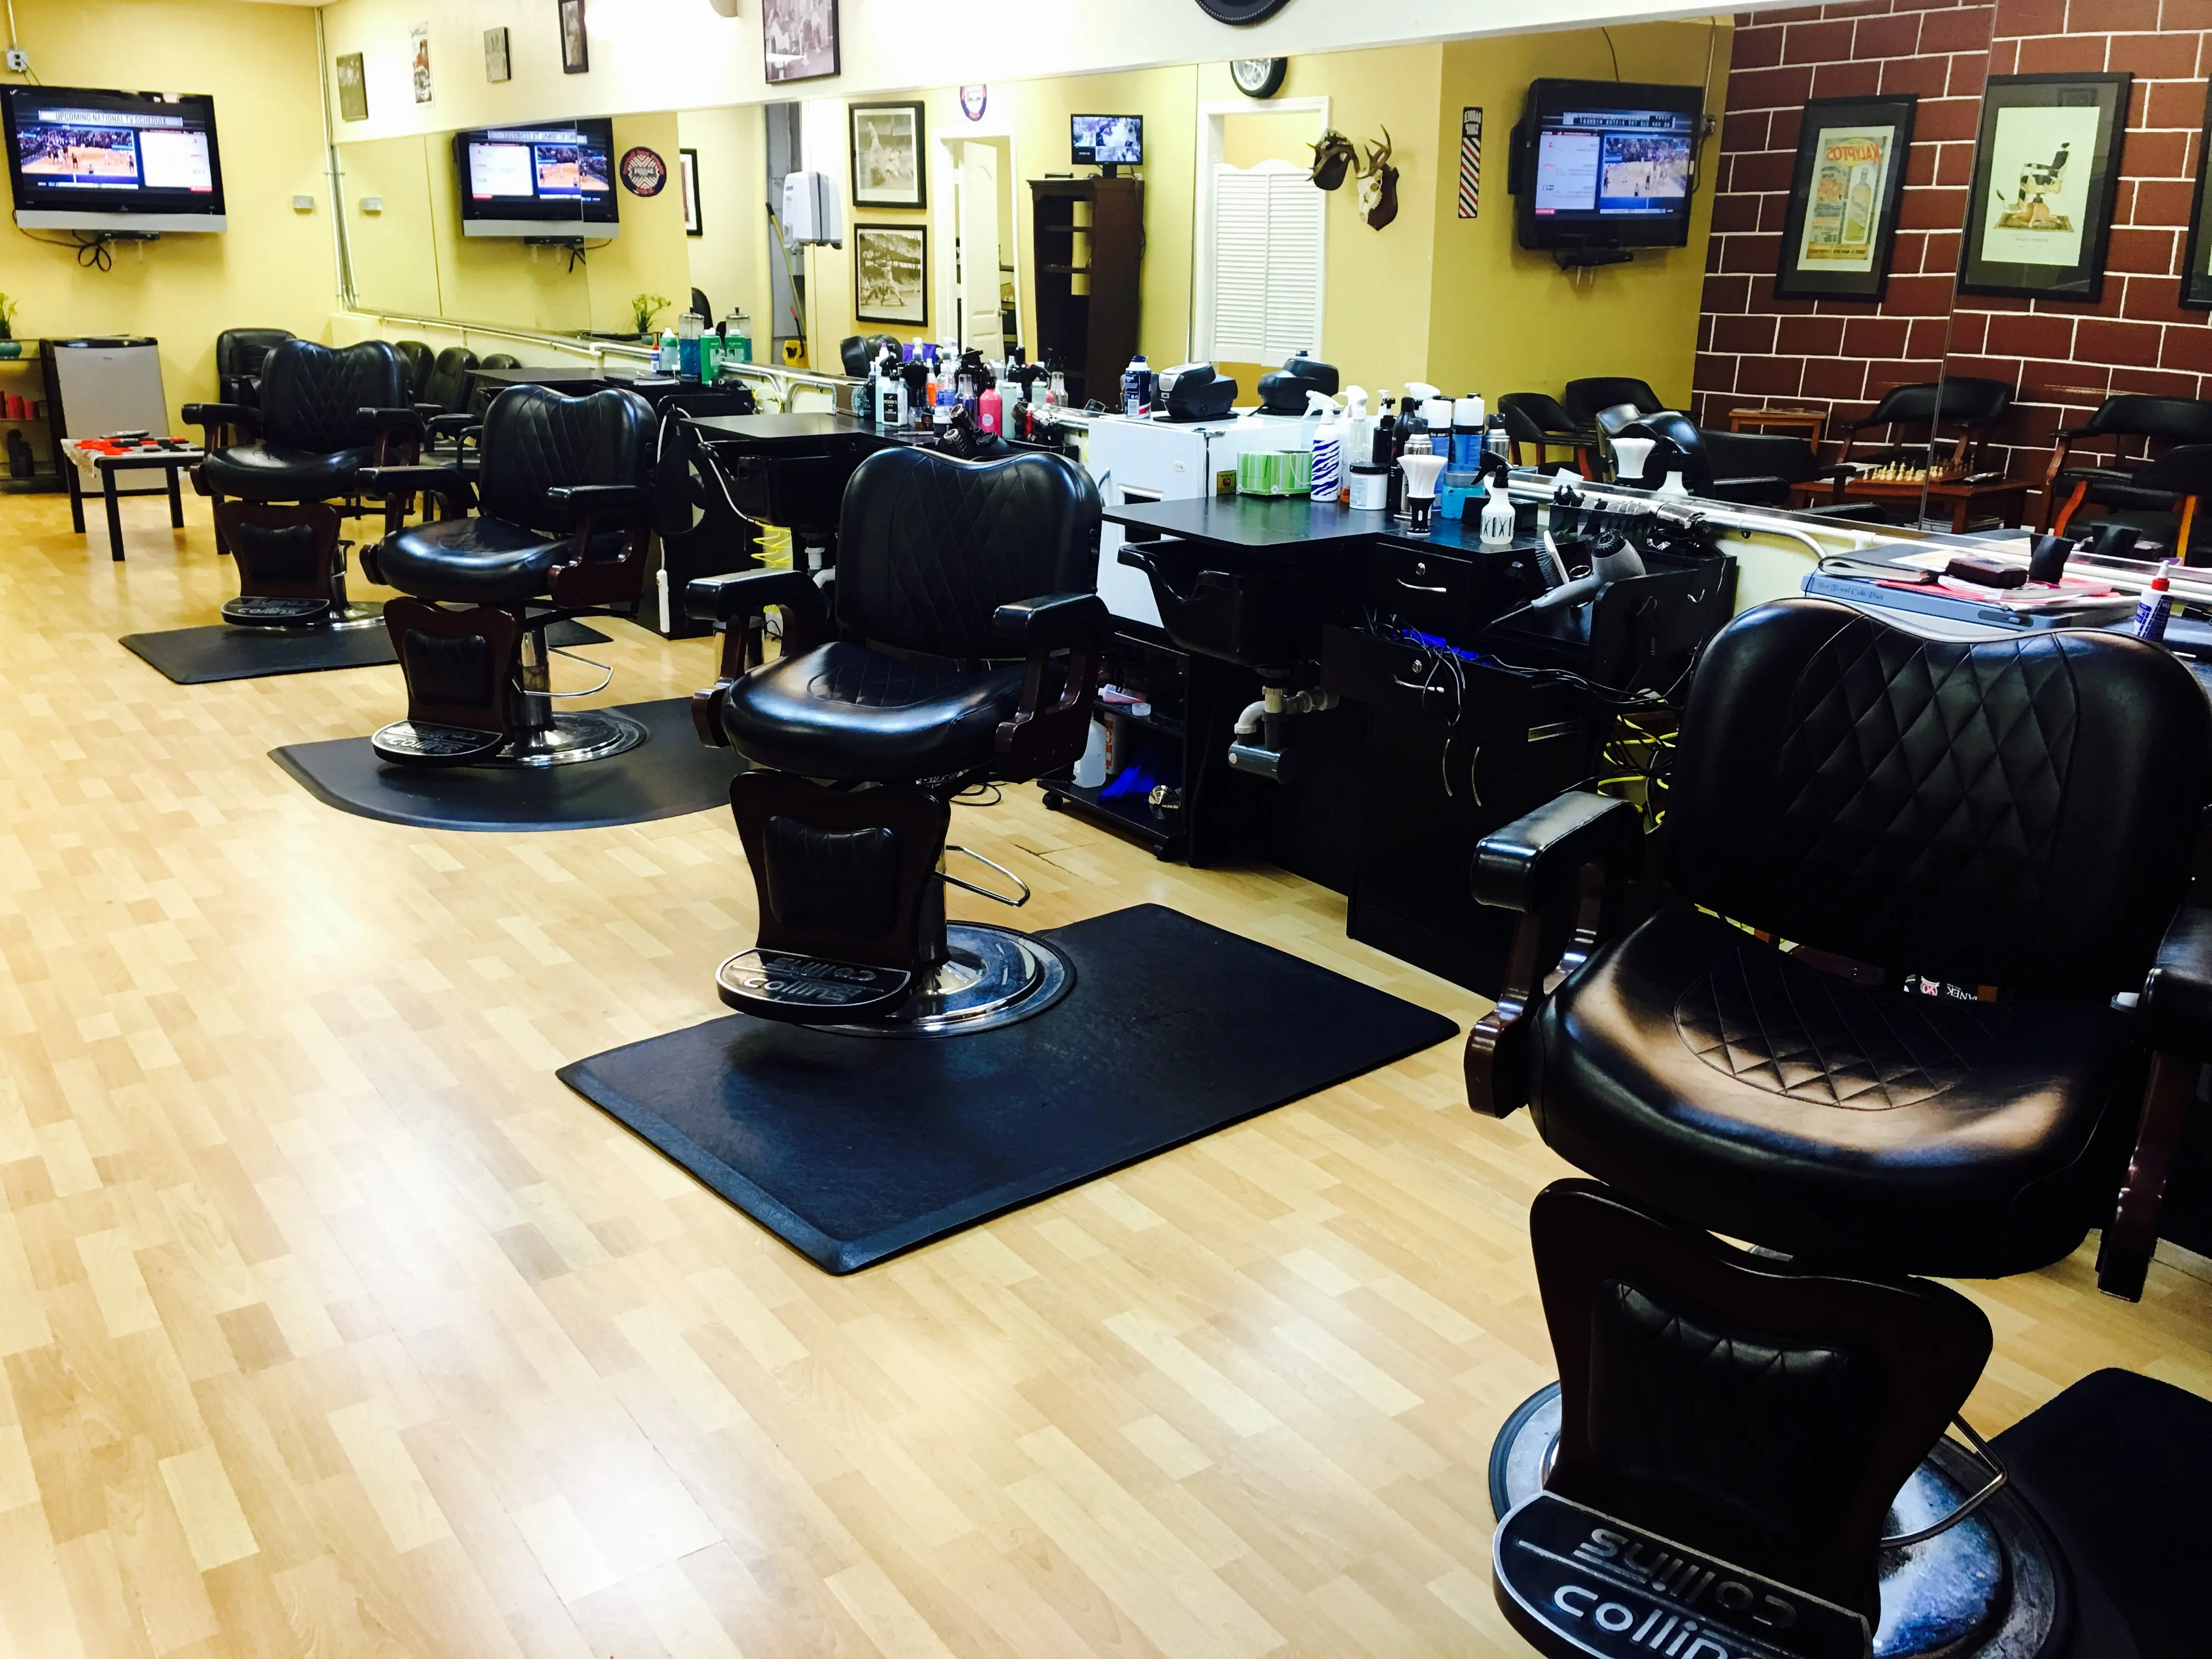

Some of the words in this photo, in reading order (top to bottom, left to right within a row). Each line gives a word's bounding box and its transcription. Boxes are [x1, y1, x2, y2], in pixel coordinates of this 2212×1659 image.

[55, 111, 91, 121] UPCOMING
[92, 112, 123, 123] NATIONAL
[125, 114, 134, 124] TV
[135, 115, 166, 126] SCHEDULE
[1830, 584, 1850, 594] Towel
[744, 977, 849, 1002] collins
[1579, 1528, 1797, 1628] collins
[1554, 1585, 1745, 1659] collin
